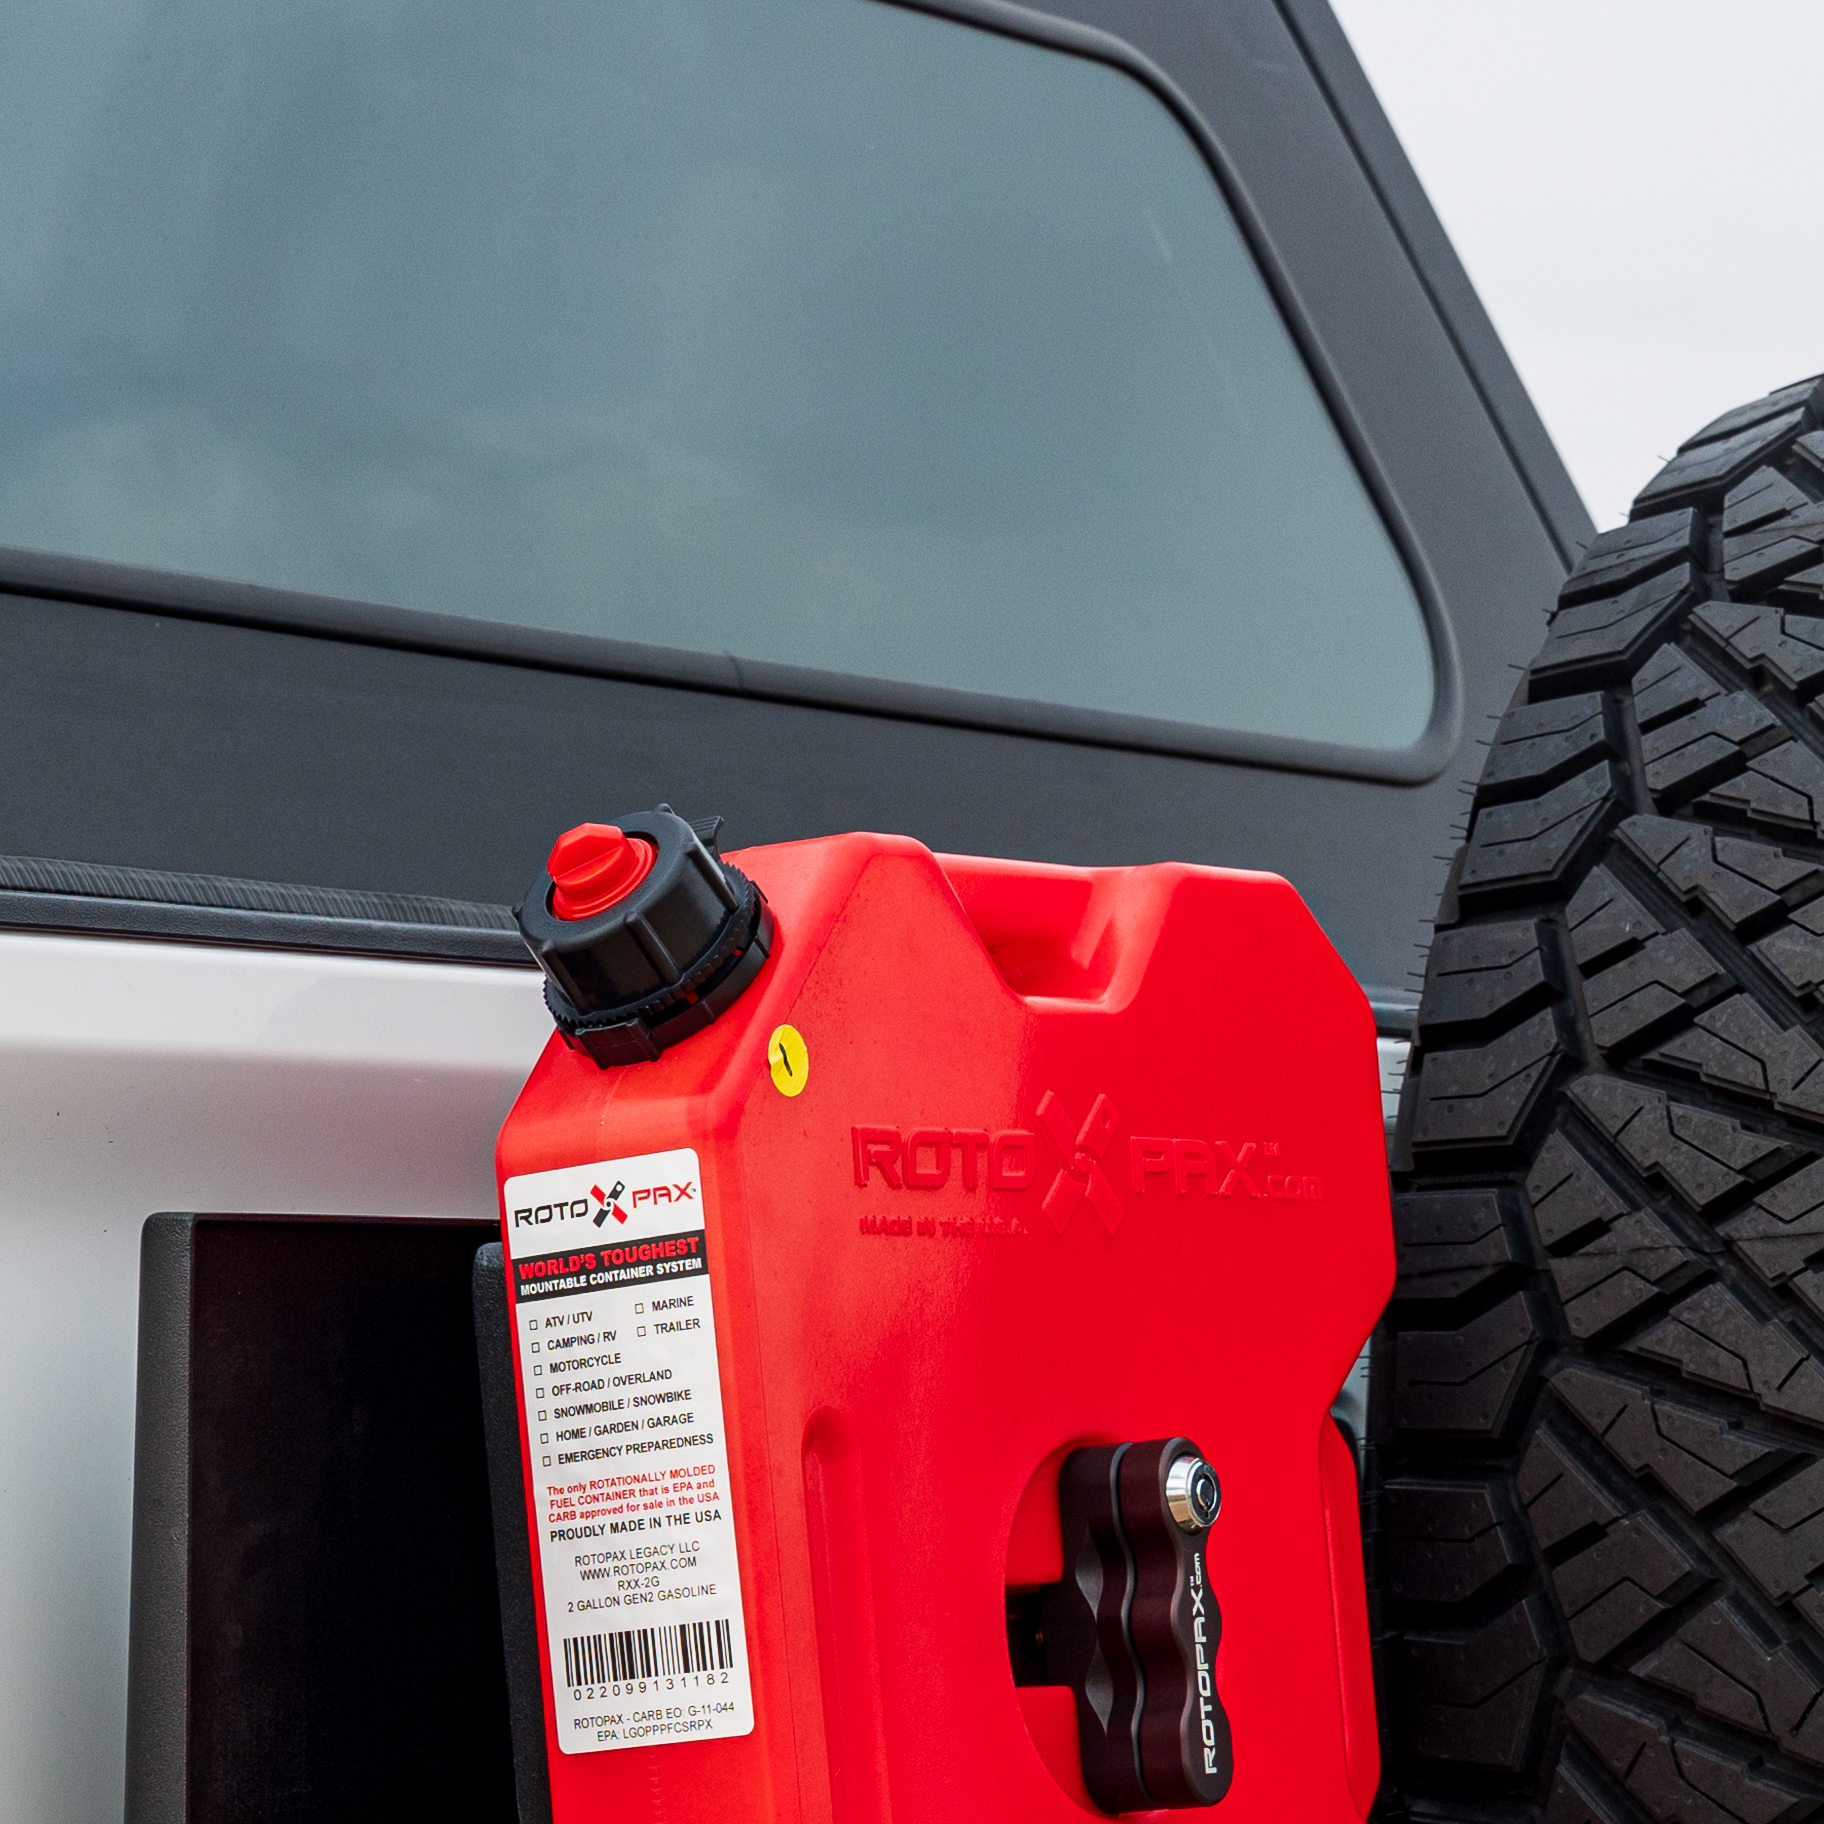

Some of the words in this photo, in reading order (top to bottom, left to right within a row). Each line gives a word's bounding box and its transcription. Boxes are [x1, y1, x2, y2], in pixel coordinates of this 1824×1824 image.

[518, 1252, 596, 1280] WORLD'S
[603, 1237, 699, 1267] TOUGHEST
[520, 1276, 587, 1296] MOUNTABLE
[589, 1266, 654, 1285] CONTAINER
[656, 1258, 702, 1275] SYSTEM
[651, 1296, 694, 1312] MARINE
[544, 1316, 565, 1329] ATV
[572, 1311, 593, 1324] UTV
[654, 1318, 701, 1335] TRAILER
[547, 1336, 595, 1351] CAMPING
[603, 1330, 617, 1343] RV
[549, 1353, 622, 1374] MOTORCYCLE
[551, 1379, 605, 1397] OFF-ROAD
[612, 1369, 673, 1388] OVERLAND
[554, 1399, 625, 1419] SNOWMOBILE
[632, 1389, 692, 1407] SNOWBIKE
[556, 1426, 586, 1442] HOME
[593, 1420, 639, 1437] GARDEN
[647, 1412, 694, 1430] GARAGE
[558, 1448, 623, 1465] EMERGENCY
[625, 1433, 714, 1456] PREPAREDNESS
[547, 1484, 564, 1496] The
[566, 1480, 587, 1496] only
[589, 1470, 667, 1490] ROTATIONALLY
[669, 1464, 716, 1479] MOLDED
[549, 1497, 575, 1509] FUEL
[577, 1488, 636, 1507] CONTAINER
[638, 1485, 658, 1497] that
[660, 1484, 669, 1495] is
[672, 1481, 694, 1493] EPA
[696, 1479, 715, 1491] and
[548, 1510, 577, 1523] CARB
[579, 1504, 624, 1521] approved
[625, 1502, 641, 1513] for
[643, 1499, 664, 1511] sale
[666, 1498, 676, 1508] in
[678, 1495, 695, 1507] the
[697, 1491, 720, 1504] USA
[549, 1524, 606, 1543] PROUDLY
[609, 1518, 646, 1534] MADE
[649, 1515, 662, 1530] IN
[665, 1512, 691, 1527] THE
[695, 1509, 722, 1524] USA
[574, 1550, 627, 1567] ROTOPAX
[629, 1544, 675, 1560] LEGACY
[678, 1541, 700, 1553] LLC
[580, 1557, 697, 1581] WWW.ROTOPAX.COM
[617, 1576, 660, 1591] RXX-2G
[567, 1602, 574, 1613] 2
[576, 1596, 621, 1612] GALLON
[623, 1592, 654, 1606] GEN2
[657, 1584, 717, 1602] GASOLINE
[574, 1713, 624, 1730] ROTOPAX
[632, 1709, 663, 1723] CARB
